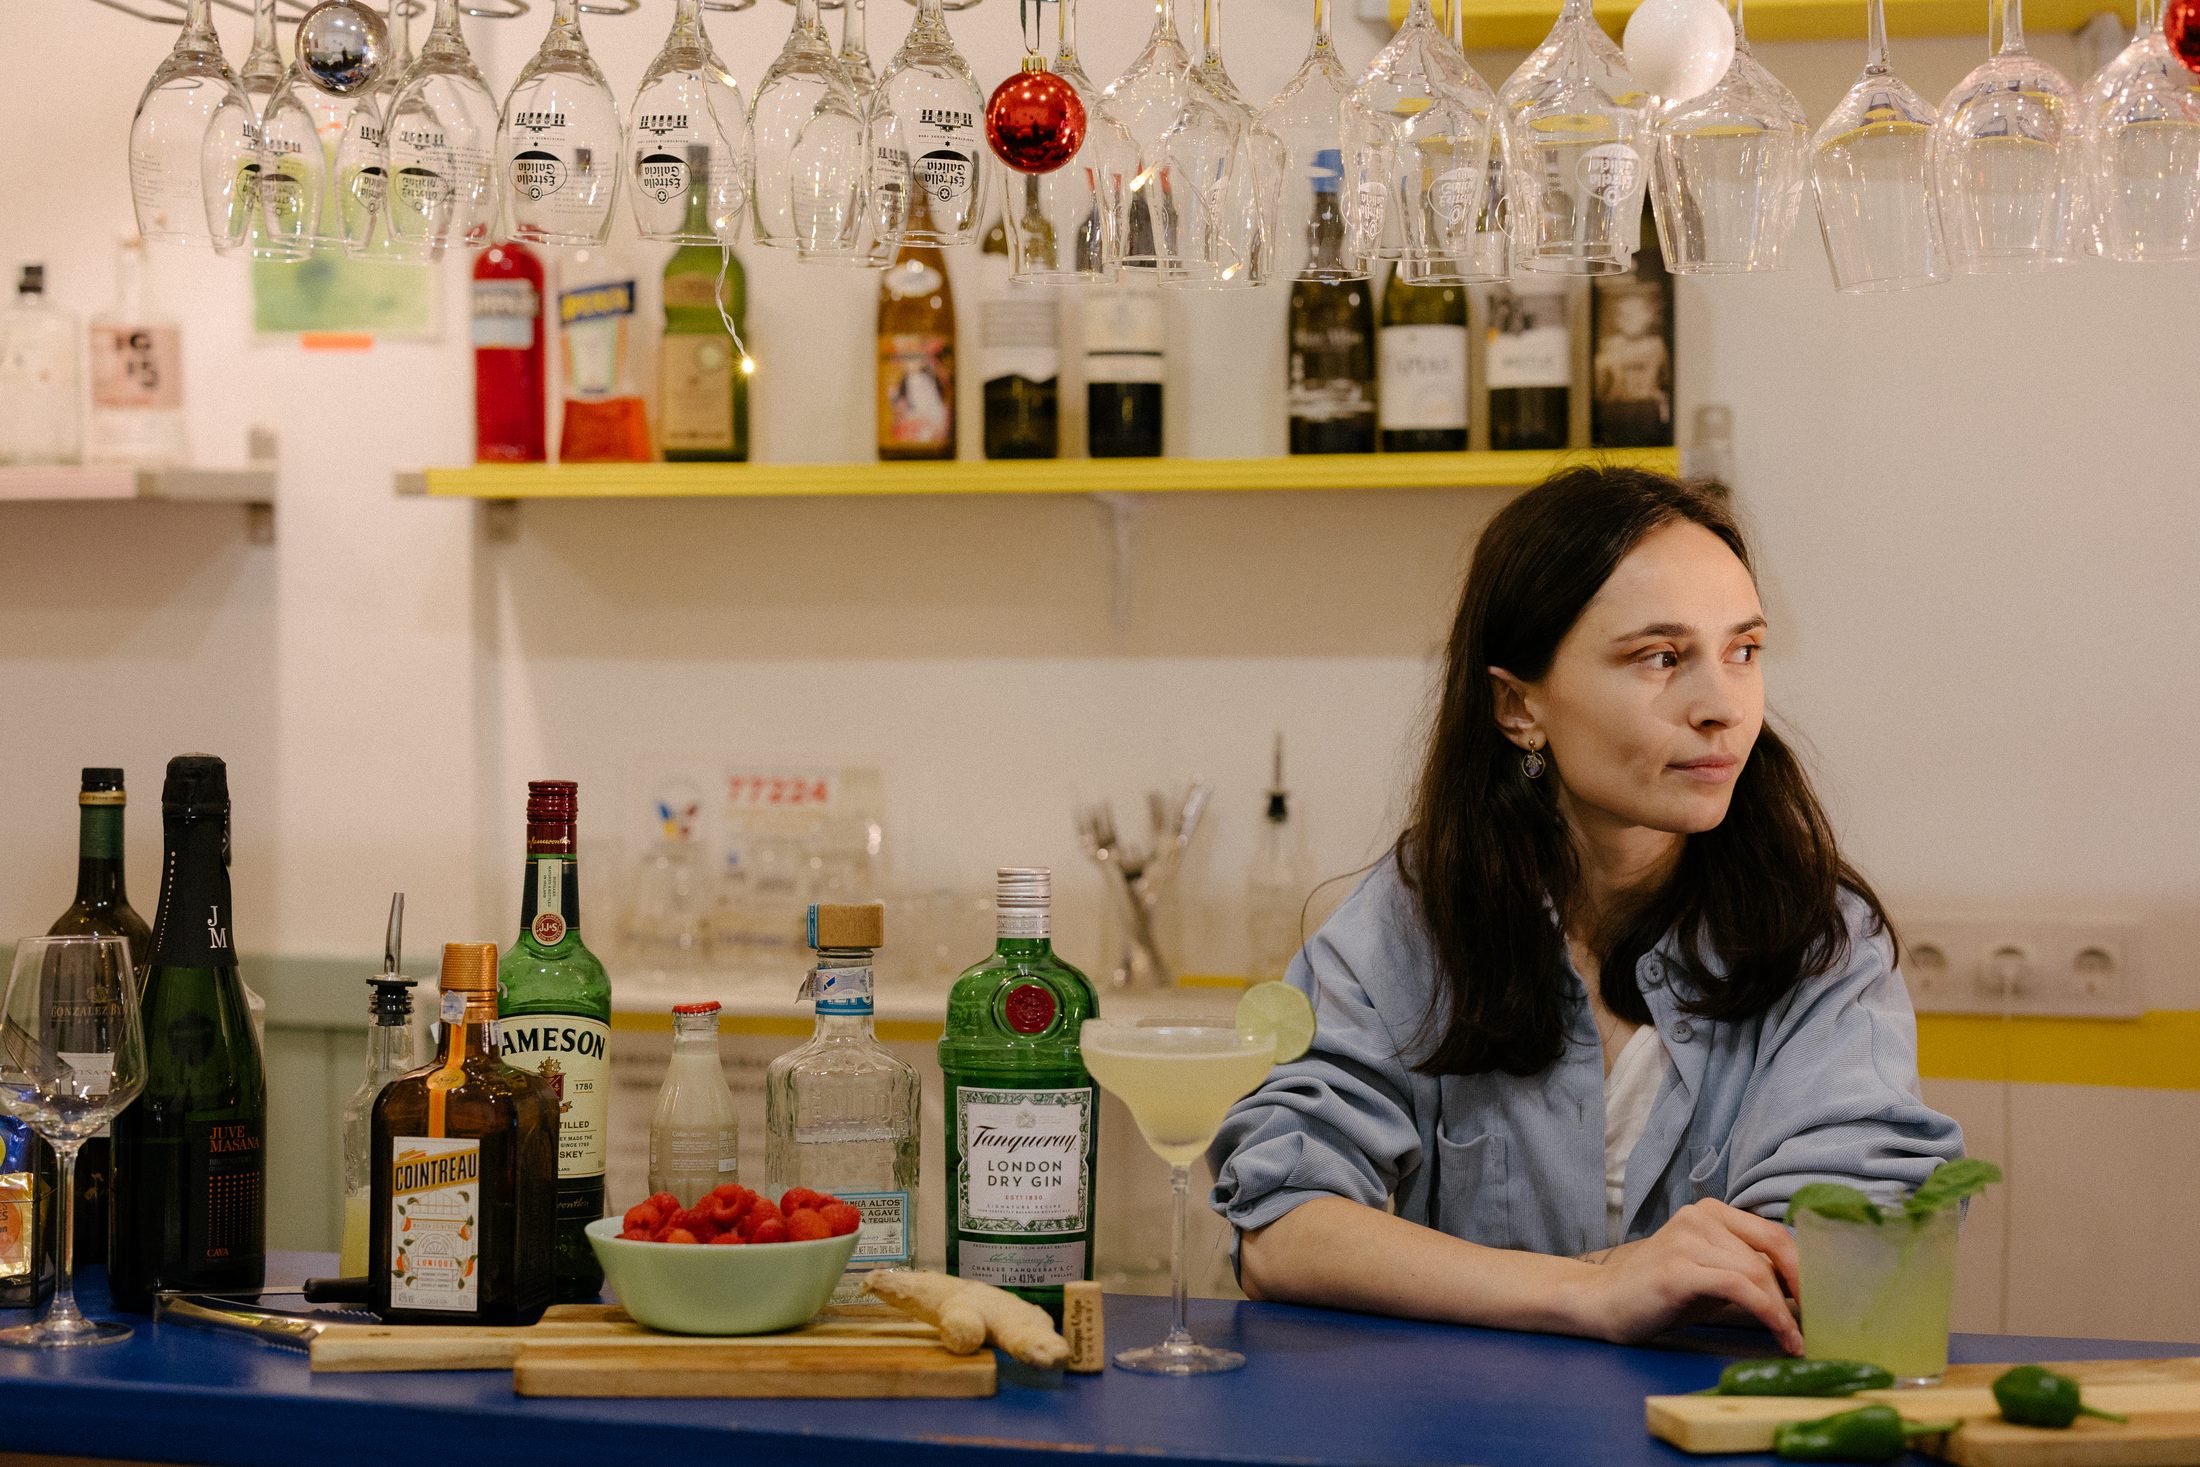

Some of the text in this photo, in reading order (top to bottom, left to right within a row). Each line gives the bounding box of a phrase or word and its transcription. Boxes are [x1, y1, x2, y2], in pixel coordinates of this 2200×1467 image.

[517, 163, 555, 175] Galicia
[644, 166, 680, 177] Galicia
[927, 161, 966, 176] Galicia
[516, 174, 556, 187] Estrella
[644, 177, 681, 189] Estrella
[924, 173, 966, 188] Estrella
[207, 905, 218, 927] J
[207, 927, 228, 949] M
[501, 1027, 606, 1061] AMESON
[575, 1083, 593, 1091] 1780
[559, 1120, 590, 1129] TILLED
[972, 1125, 1077, 1153] Tanqueray
[559, 1151, 584, 1159] SKEY
[395, 1153, 477, 1191] COINTREAU
[988, 1160, 1062, 1173] LONDON
[987, 1175, 1062, 1187] DRY GIN
[869, 1199, 900, 1207] ALTOS
[868, 1209, 900, 1217] AGAVE
[207, 1248, 229, 1257] CAVA
[1010, 1265, 1058, 1273] TANQUERAY
